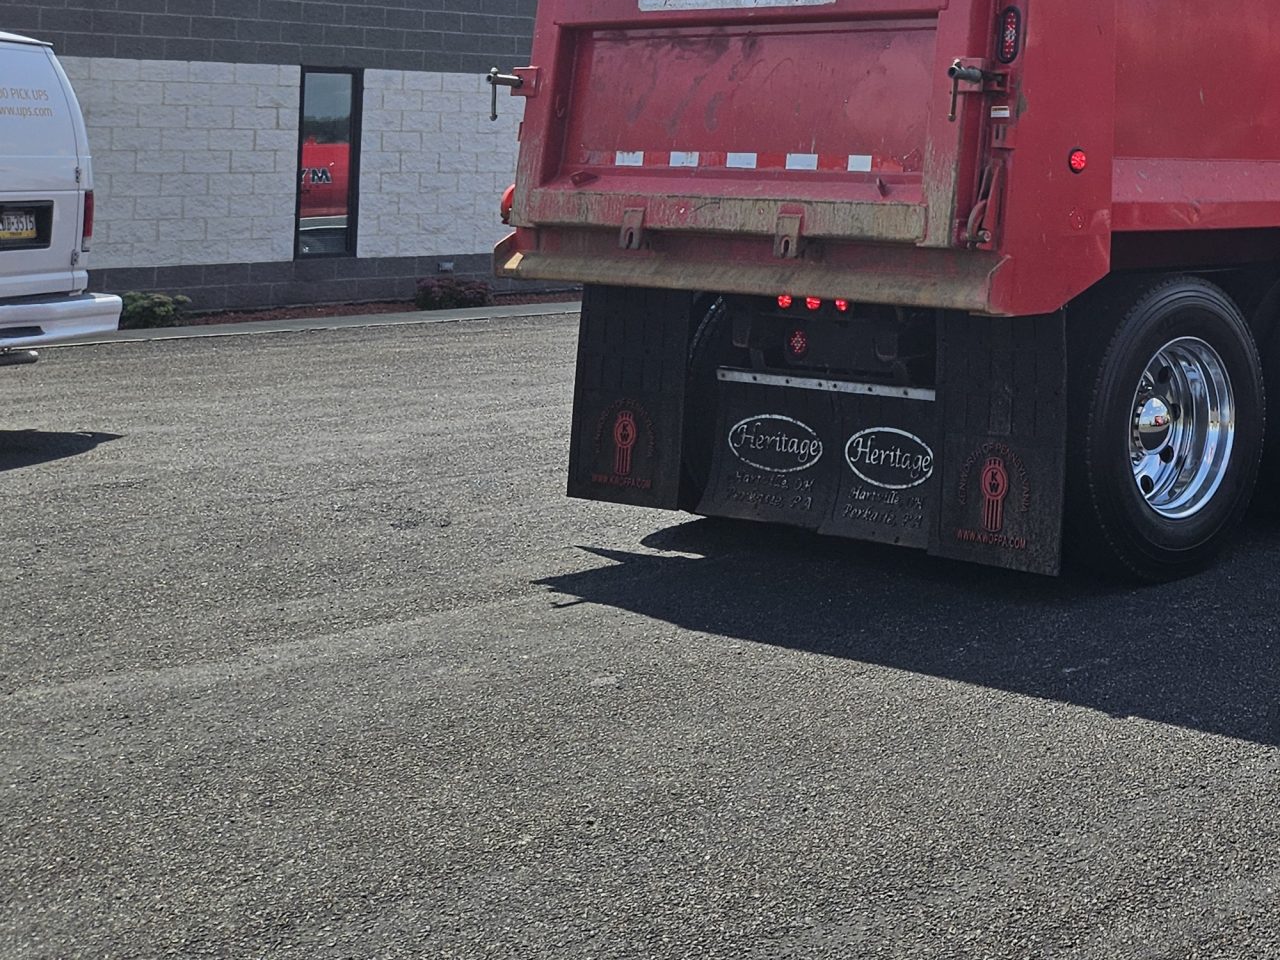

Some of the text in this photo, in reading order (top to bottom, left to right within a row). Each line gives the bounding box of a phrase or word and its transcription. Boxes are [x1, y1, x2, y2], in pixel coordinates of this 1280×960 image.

[10, 87, 31, 100] PICK
[31, 88, 49, 101] UPS
[734, 422, 819, 463] Heritage
[850, 435, 931, 479] Heritage
